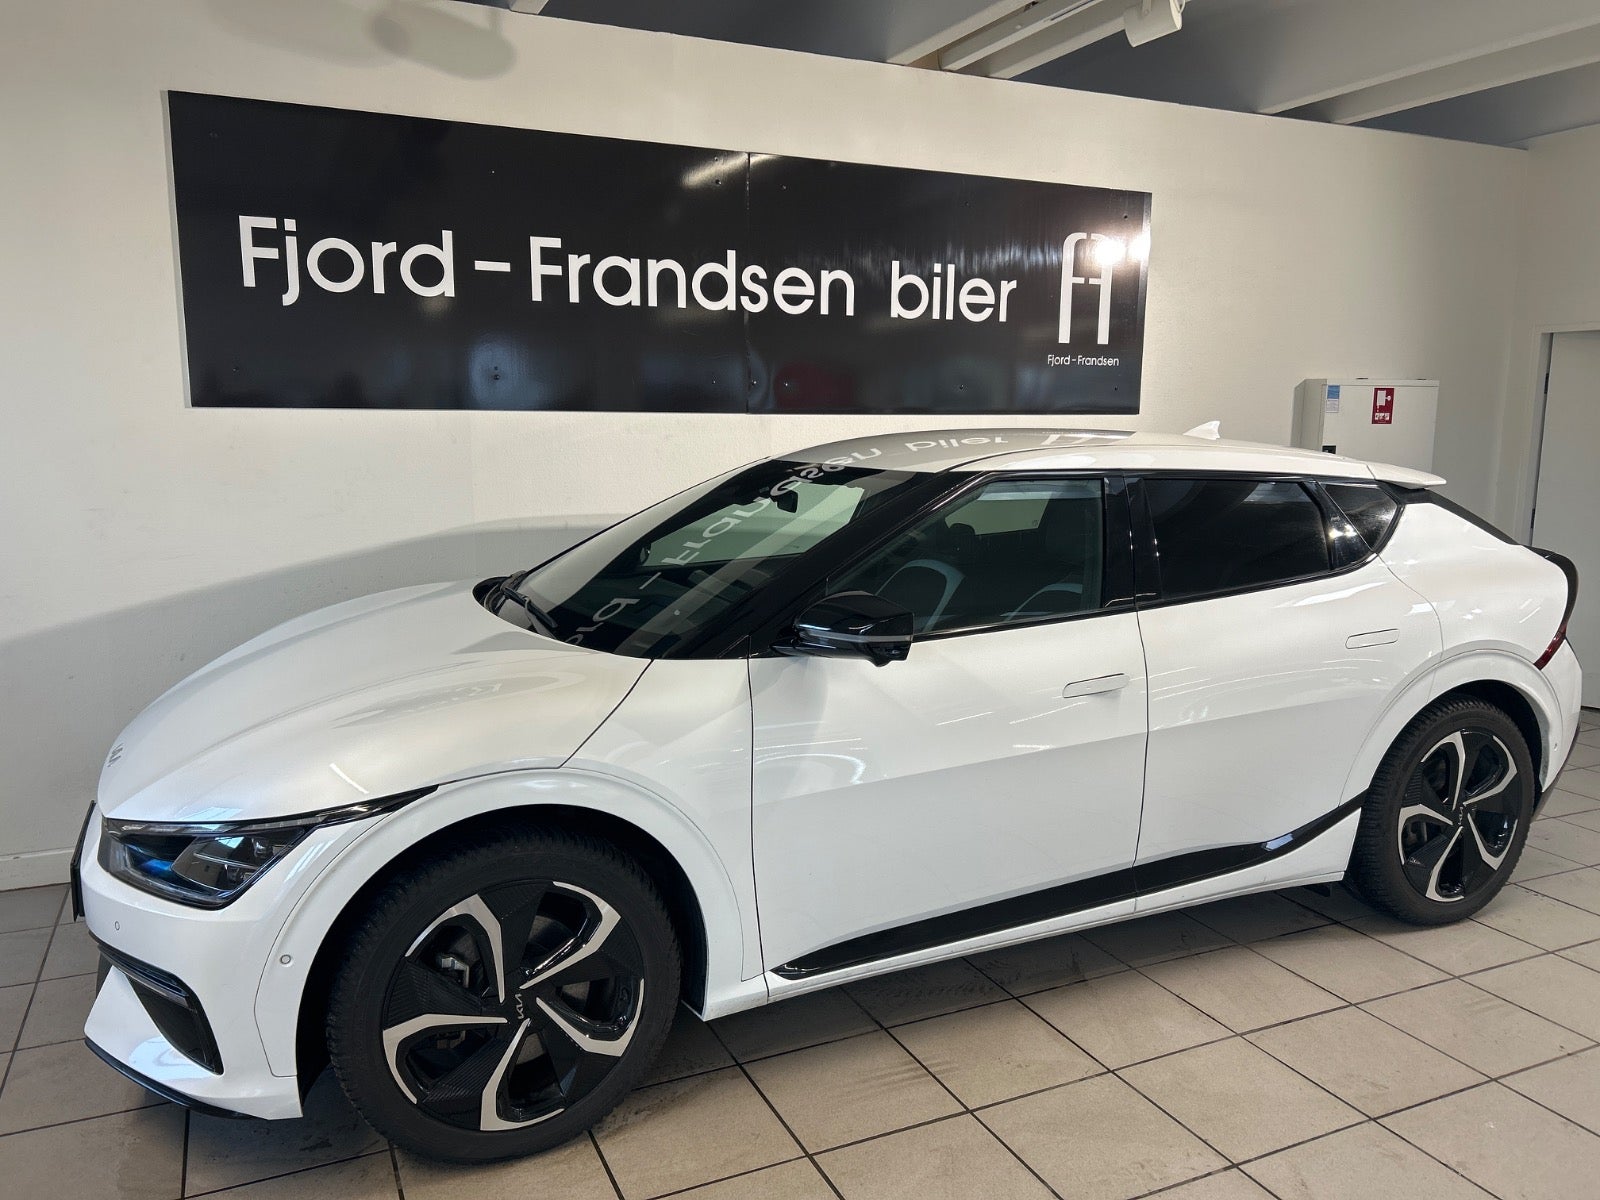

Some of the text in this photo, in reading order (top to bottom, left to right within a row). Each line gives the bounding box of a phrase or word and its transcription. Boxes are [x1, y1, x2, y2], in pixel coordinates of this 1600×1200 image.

[238, 215, 455, 306] Fjord
[530, 235, 855, 316] Frandsen
[890, 260, 1017, 323] biler
